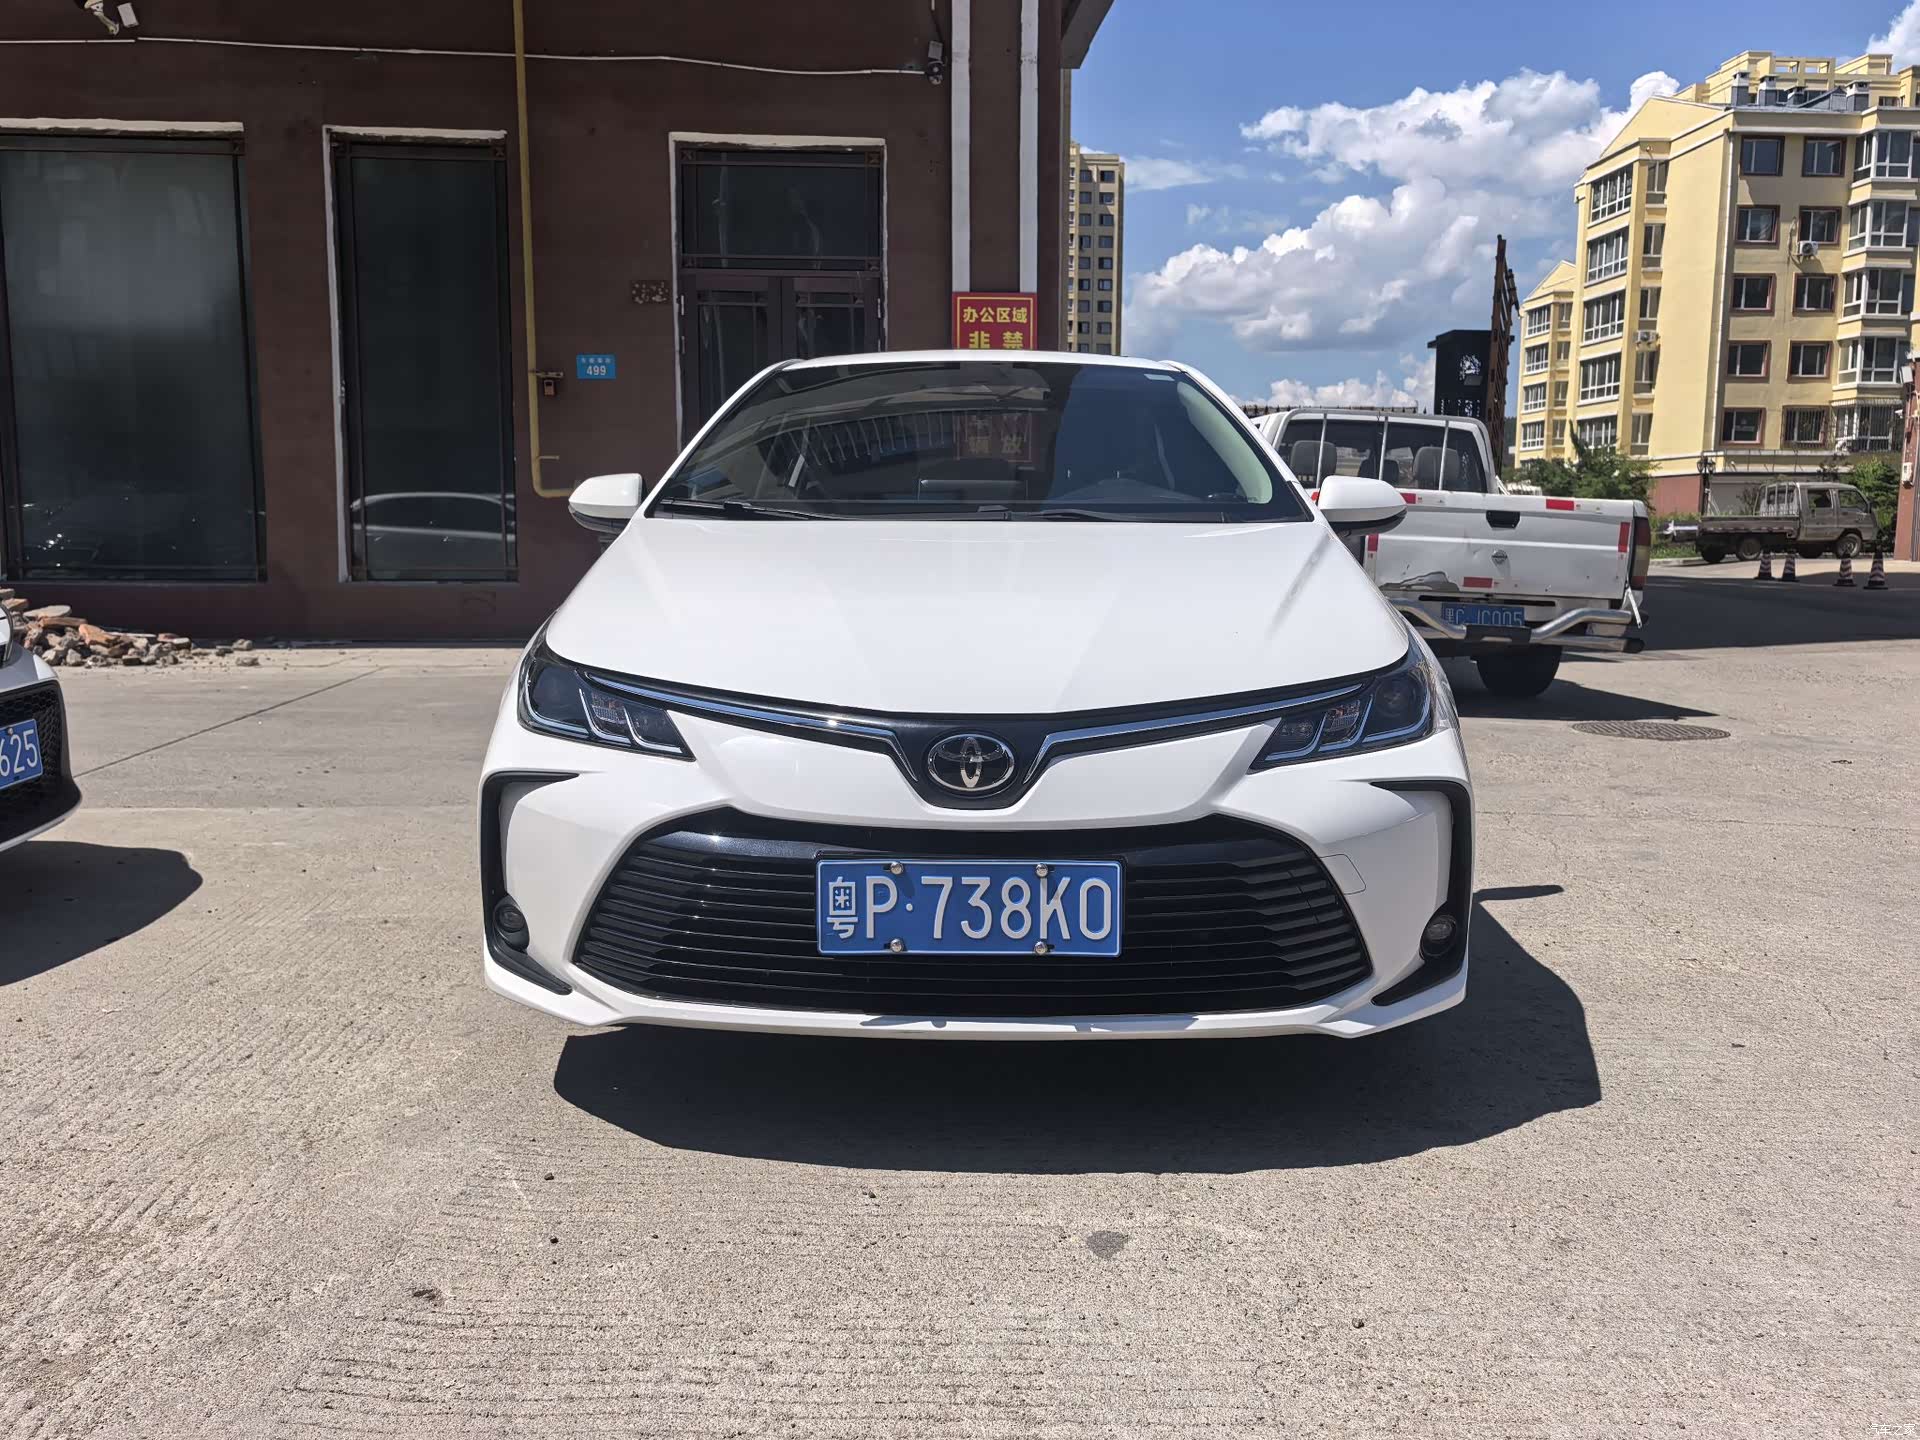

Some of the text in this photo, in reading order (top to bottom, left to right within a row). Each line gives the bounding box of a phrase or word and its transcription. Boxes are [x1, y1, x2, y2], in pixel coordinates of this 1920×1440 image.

[963, 306, 1027, 323] 办公区域
[586, 365, 606, 376] 499
